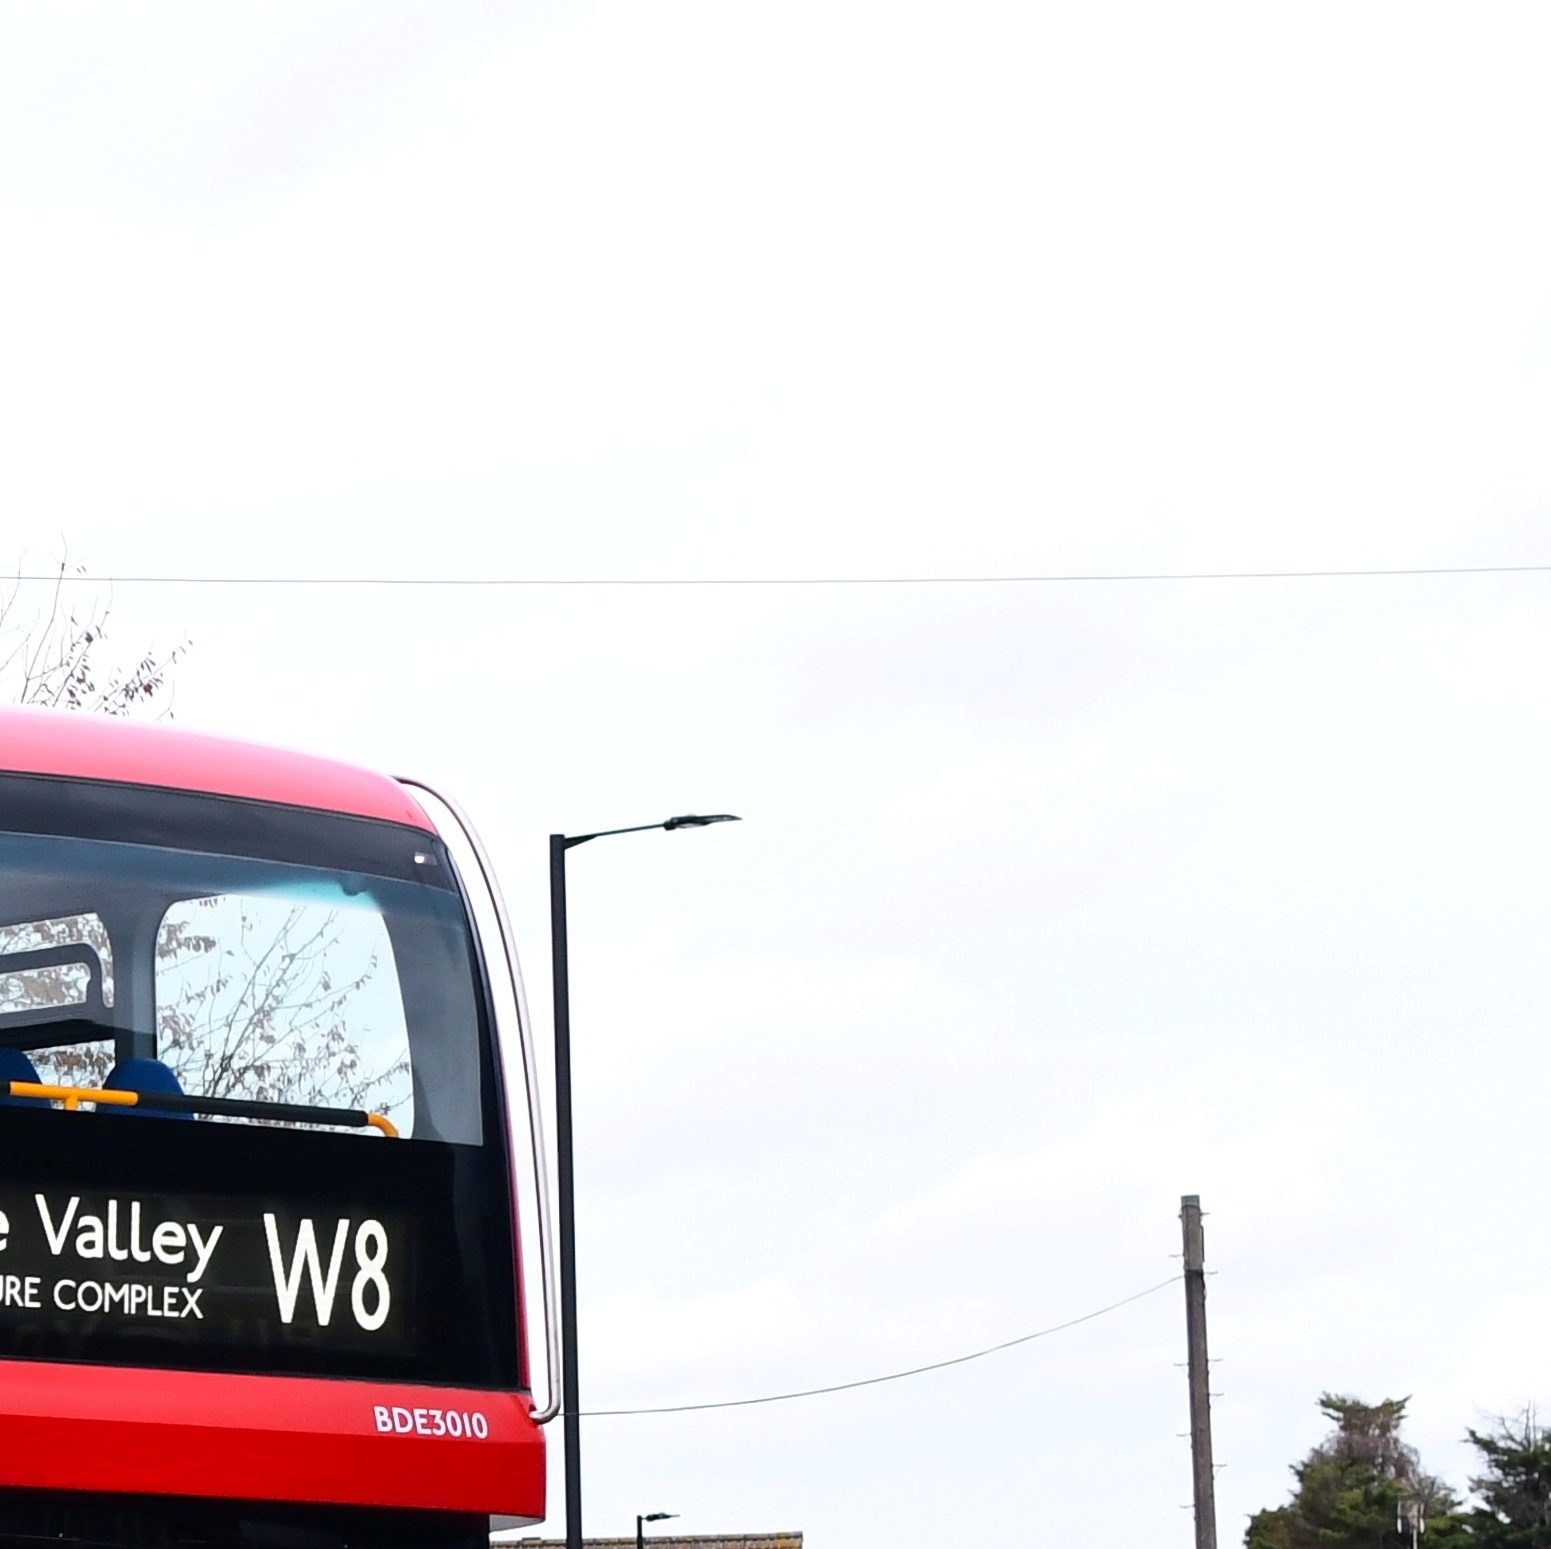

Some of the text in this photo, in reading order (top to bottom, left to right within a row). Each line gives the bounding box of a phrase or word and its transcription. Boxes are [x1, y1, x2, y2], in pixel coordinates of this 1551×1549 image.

[35, 1193, 224, 1282] Valley
[53, 1279, 204, 1320] COMPLEX
[263, 1212, 391, 1331] W8
[373, 1405, 488, 1439] BDE3010
